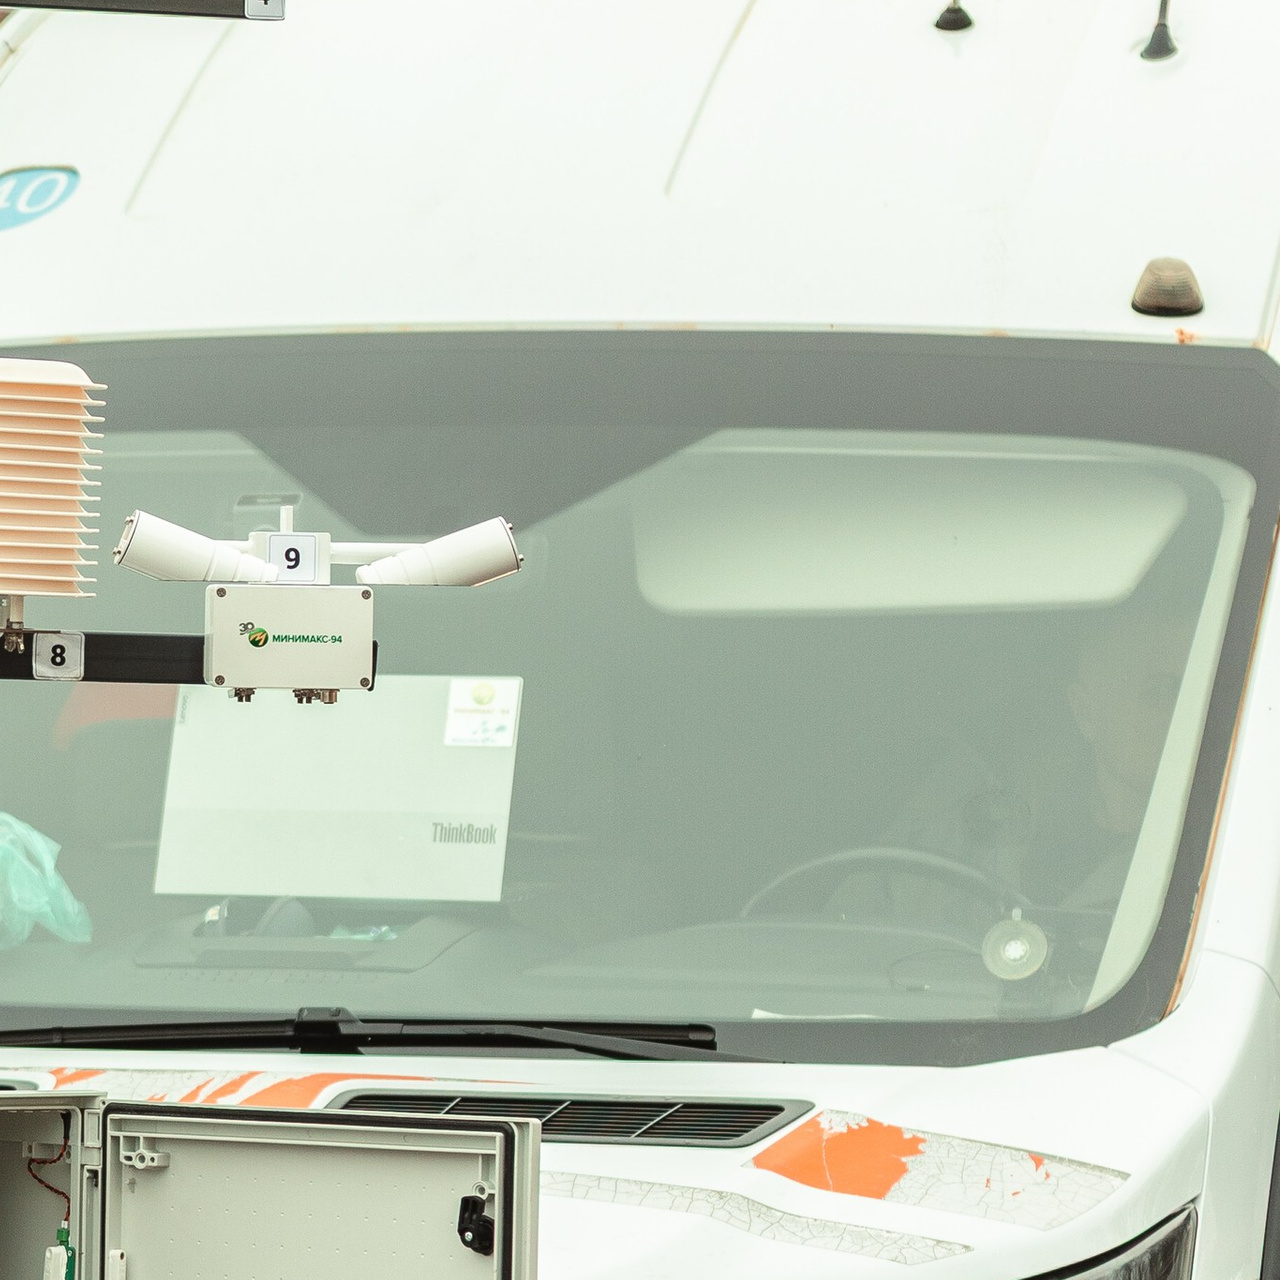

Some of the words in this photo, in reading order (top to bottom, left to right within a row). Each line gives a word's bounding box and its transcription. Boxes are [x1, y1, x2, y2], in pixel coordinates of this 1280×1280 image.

[284, 547, 301, 570] 9
[272, 634, 343, 644] МИНИМАКС-94
[50, 644, 66, 667] 8
[432, 822, 497, 844] ThinkBook
